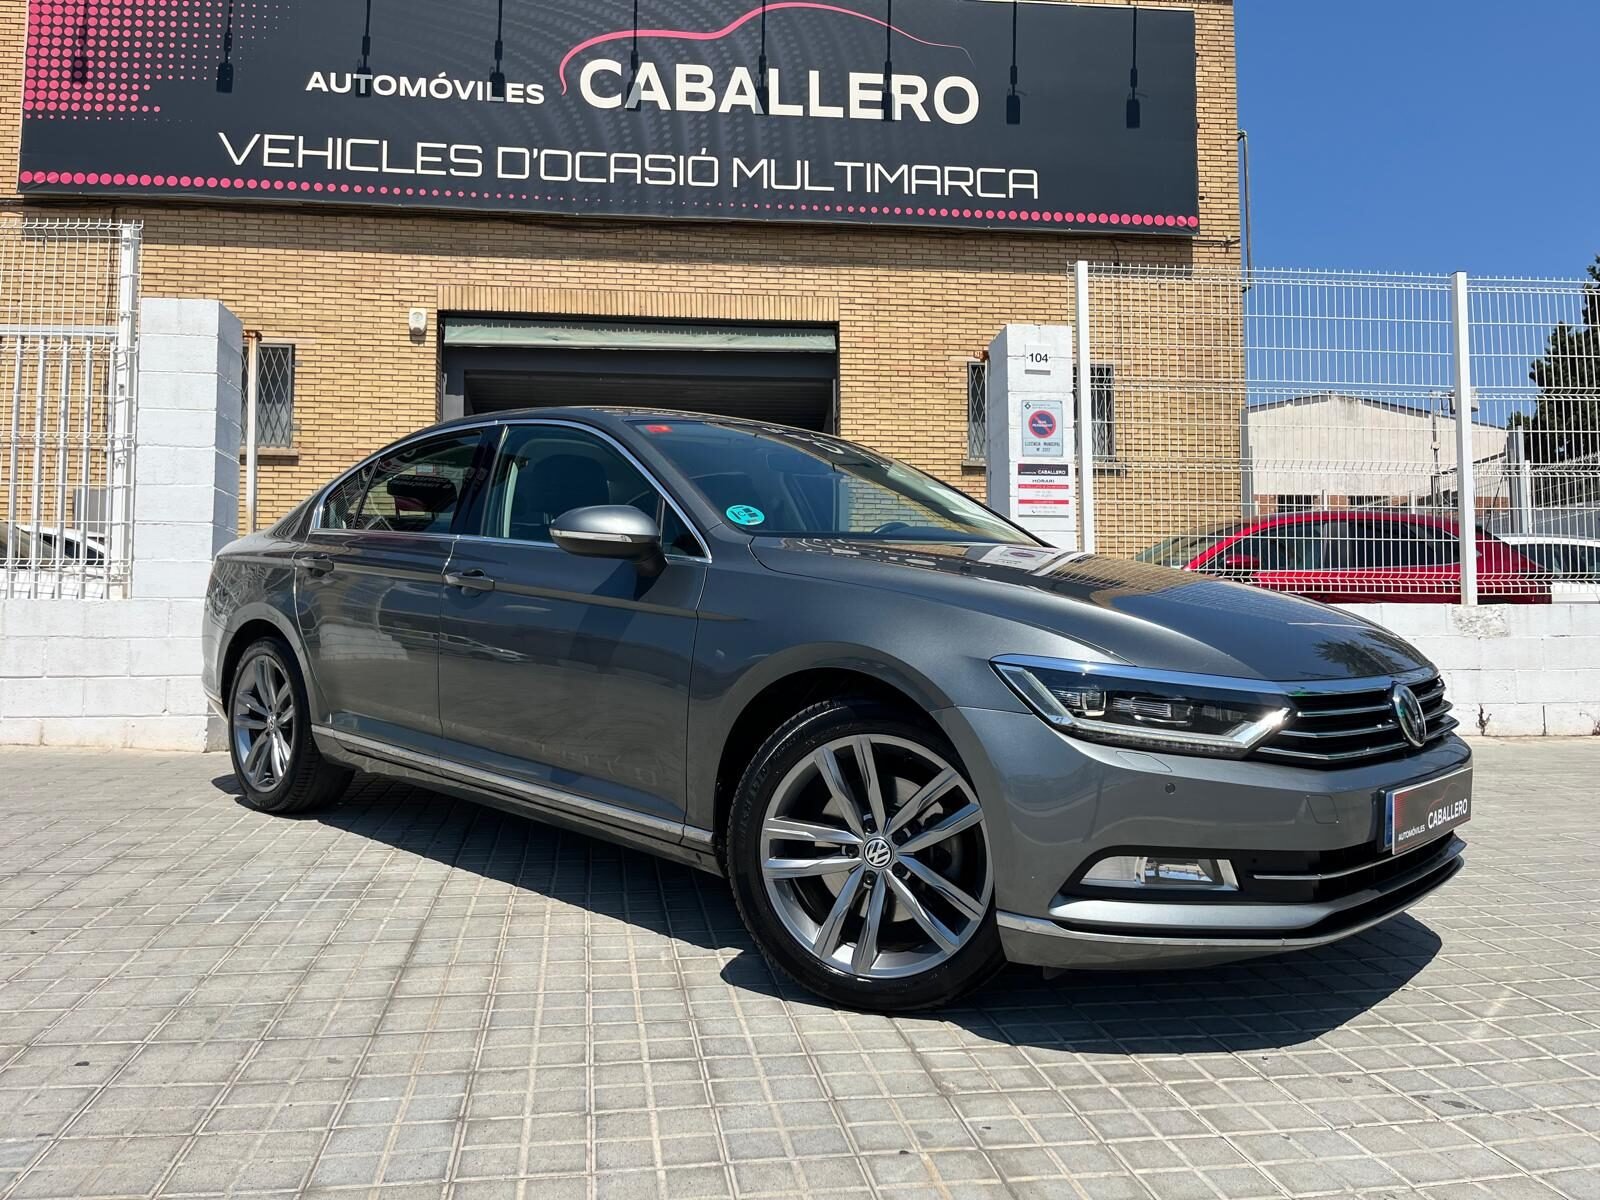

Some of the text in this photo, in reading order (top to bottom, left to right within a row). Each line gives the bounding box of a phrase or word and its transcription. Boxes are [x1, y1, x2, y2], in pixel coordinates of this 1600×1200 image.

[305, 58, 980, 125] AUTOMÓVILES CABALLERO
[217, 131, 1039, 200] VEHICLES D'OCASIÓ MULTIMARCA
[1028, 353, 1049, 363] 104
[1398, 798, 1468, 841] AUTOMÓVILES CABALLERO
